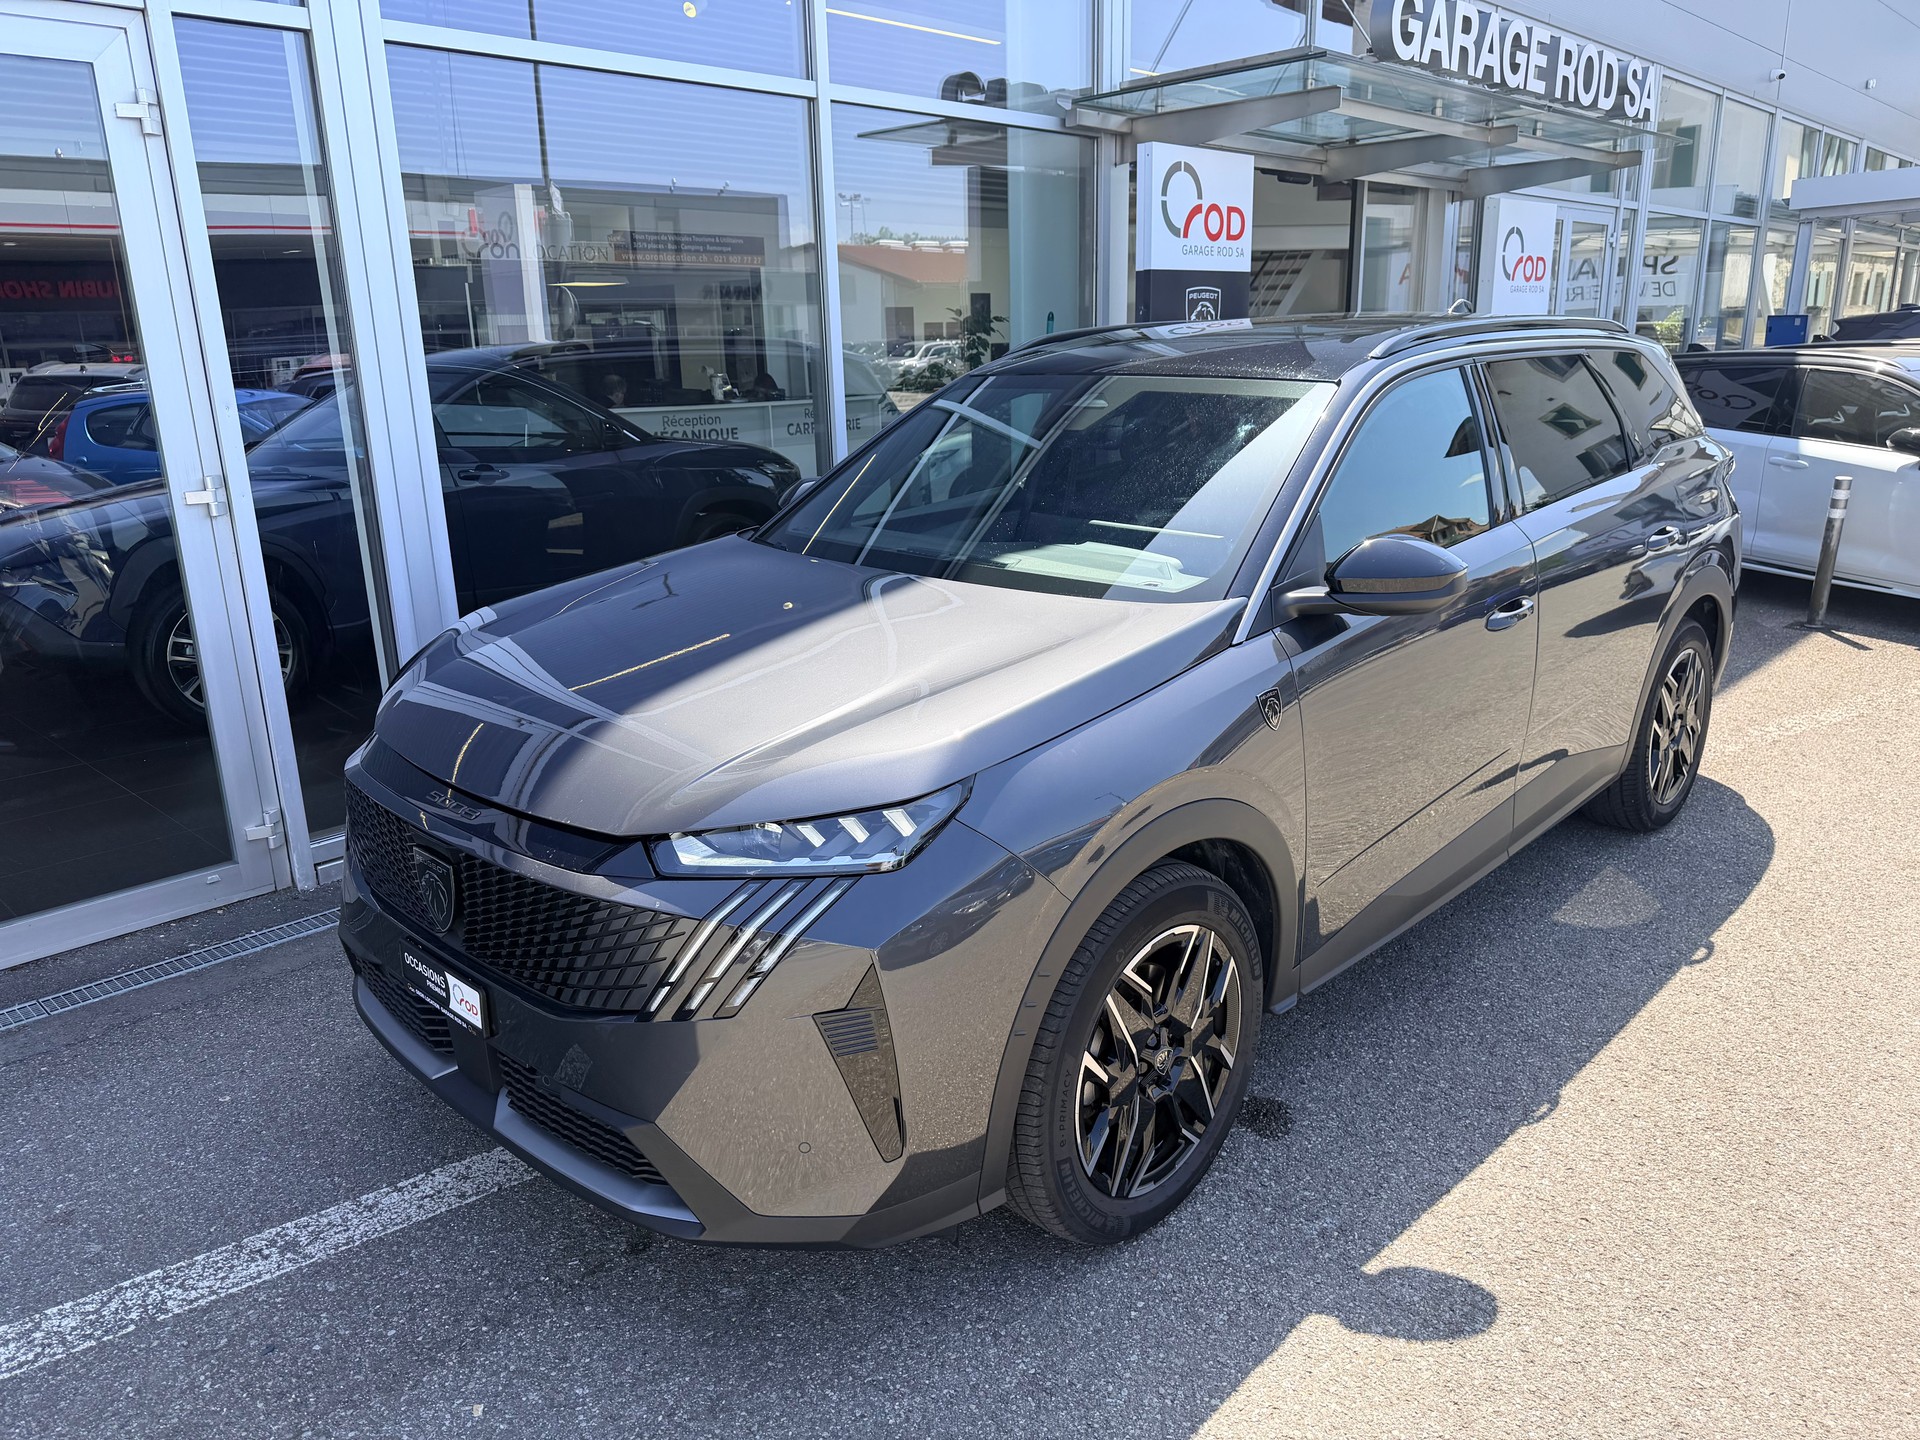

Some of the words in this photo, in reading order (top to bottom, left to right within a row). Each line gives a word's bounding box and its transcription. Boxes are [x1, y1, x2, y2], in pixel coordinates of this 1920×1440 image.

[1391, 0, 1551, 95] GARAGE
[1554, 35, 1619, 111] ROD
[1623, 57, 1656, 122] SA
[1181, 244, 1214, 257] GARAGE
[1217, 246, 1234, 258] ROD
[1235, 247, 1245, 258] SA
[1188, 292, 1218, 300] PEUGEOT
[662, 414, 721, 428] Réception
[426, 790, 481, 820] 5008
[404, 952, 446, 989] OCCASIONS
